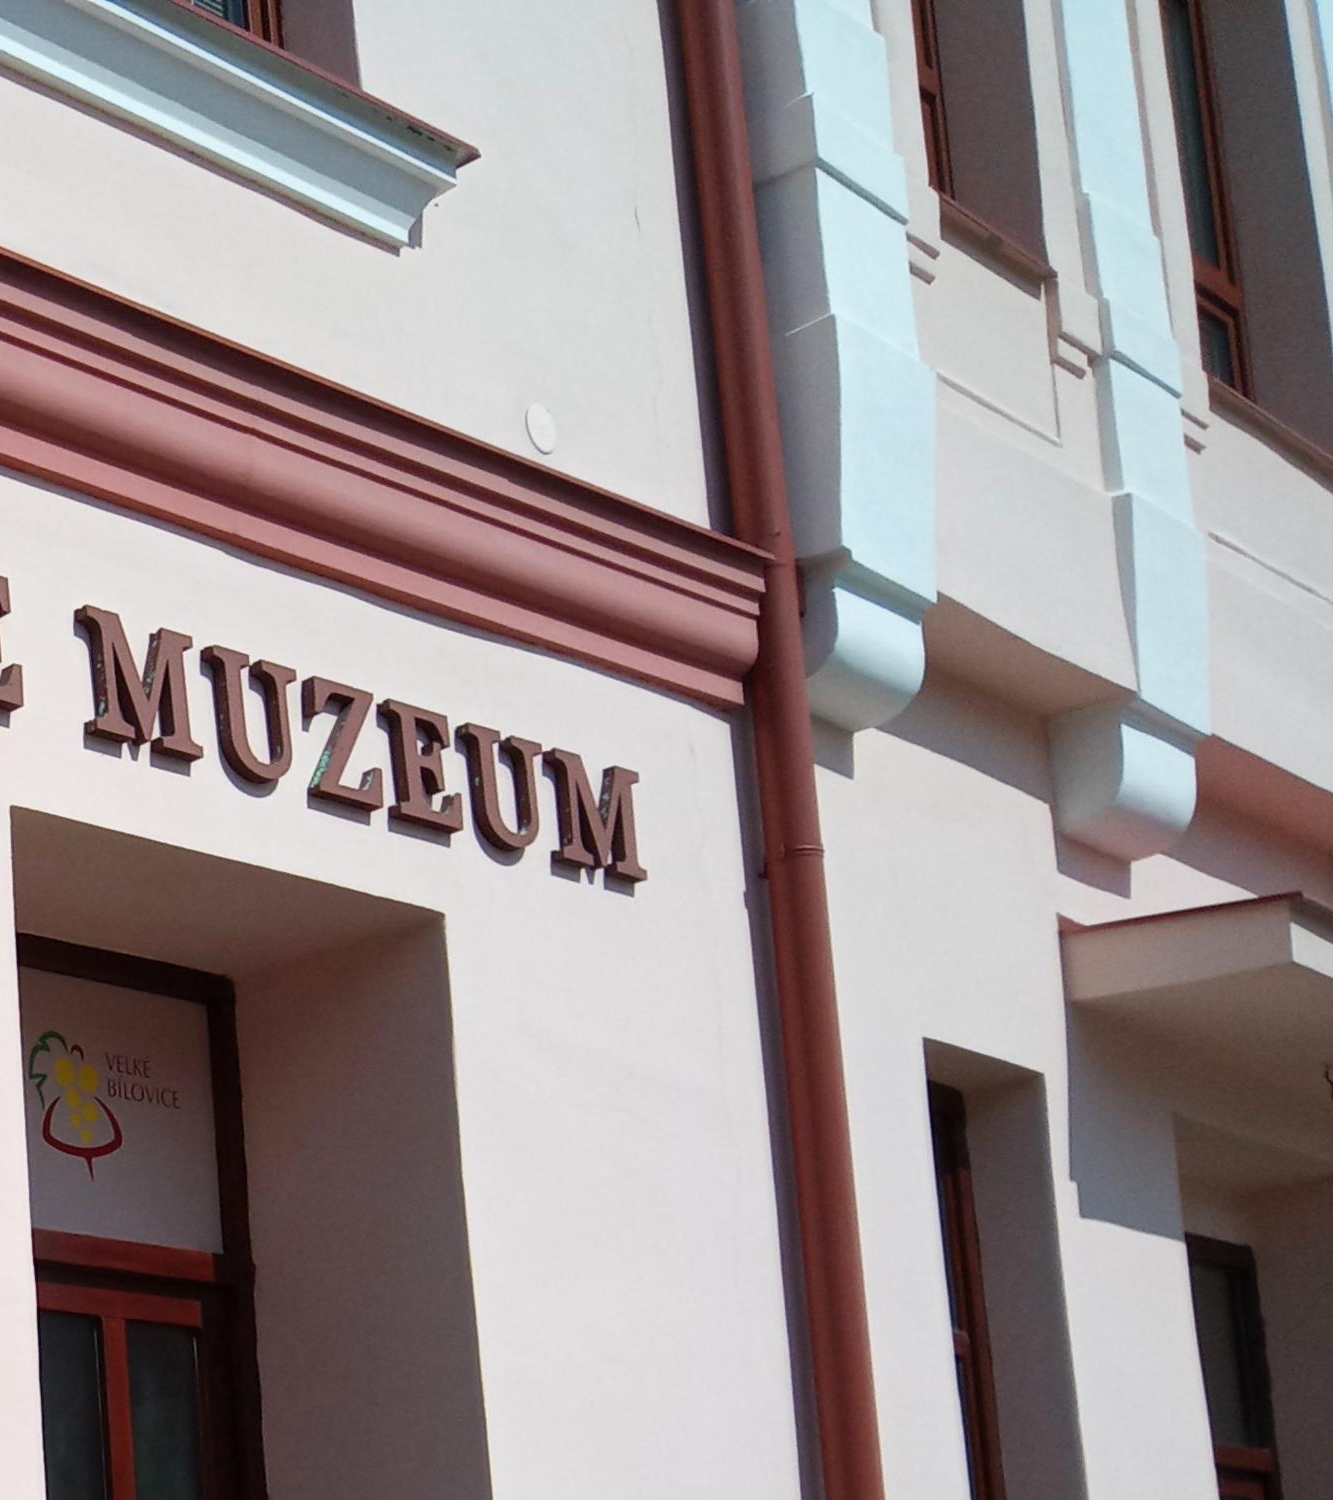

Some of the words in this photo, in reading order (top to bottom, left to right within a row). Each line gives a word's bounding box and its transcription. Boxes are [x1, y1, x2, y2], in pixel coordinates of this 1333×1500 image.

[75, 606, 647, 883] MUZEUM
[104, 1052, 151, 1079] VELKÉ
[107, 1075, 181, 1109] BÍLOVICE
